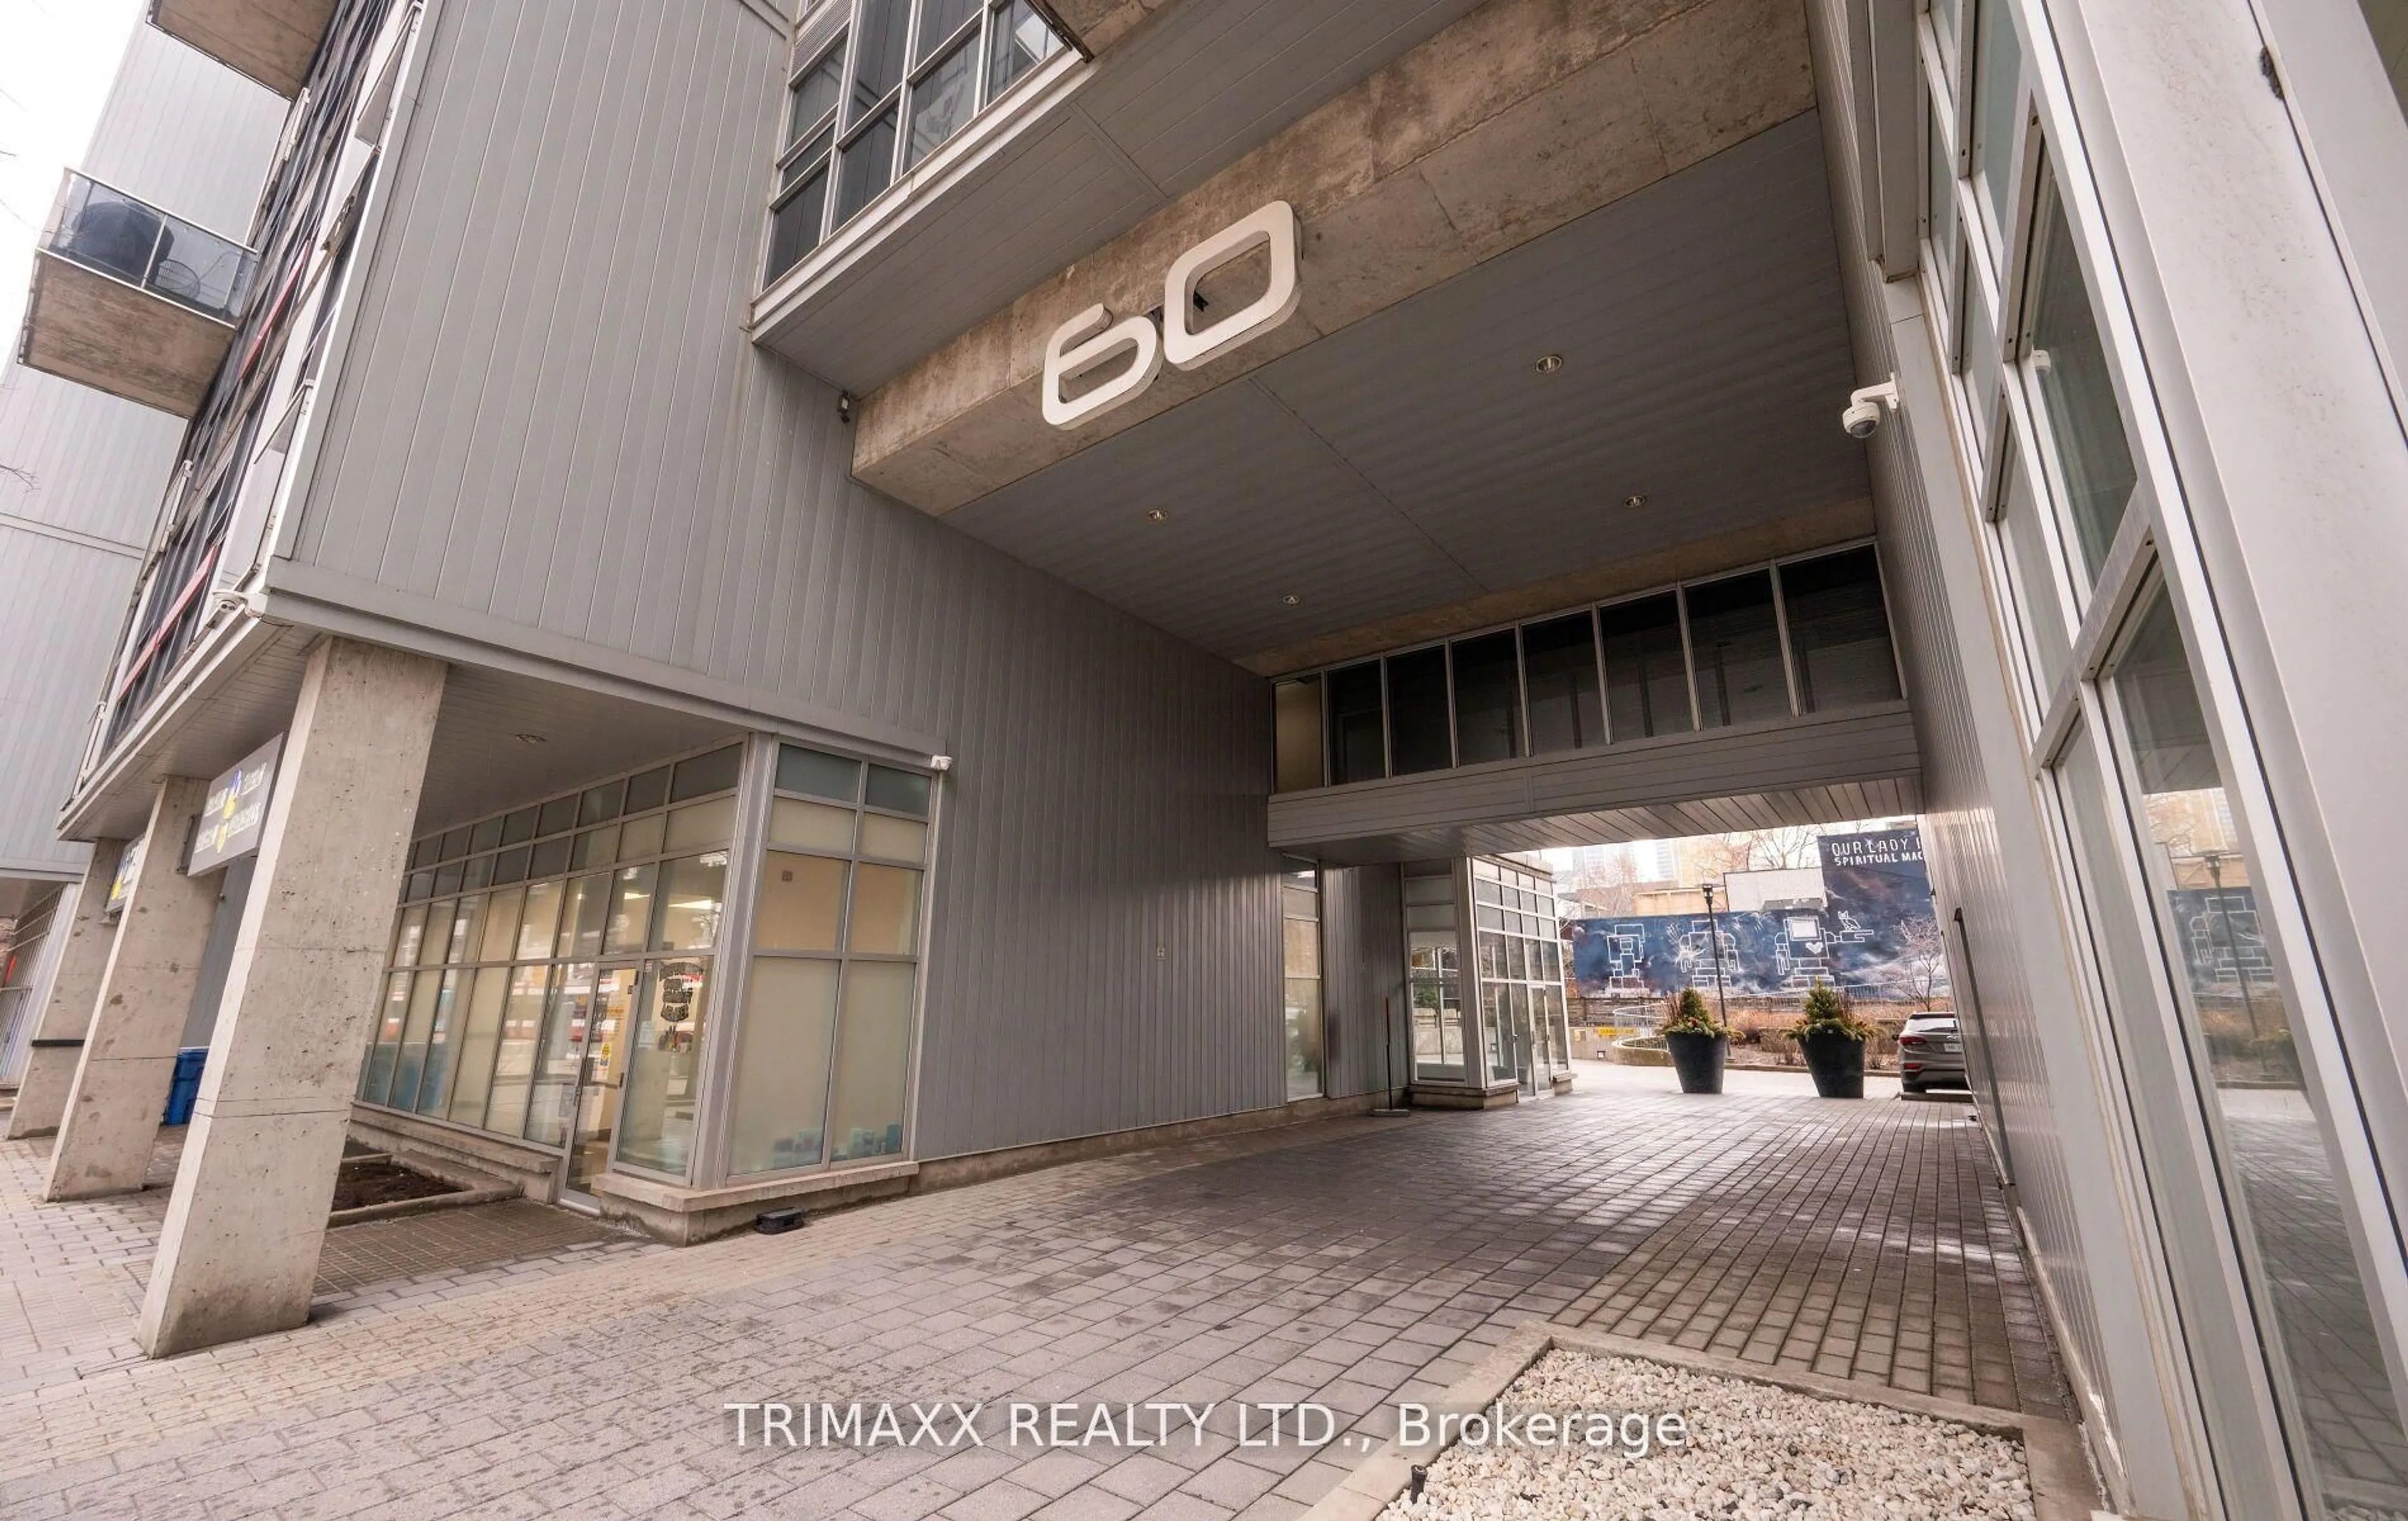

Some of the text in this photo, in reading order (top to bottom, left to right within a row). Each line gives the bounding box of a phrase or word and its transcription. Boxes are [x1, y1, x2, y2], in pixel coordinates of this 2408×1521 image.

[1042, 200, 1301, 429] 60
[1831, 842, 1862, 857] OUR
[1868, 838, 1908, 853] LADY
[1834, 853, 1899, 867] SPIRITUAL
